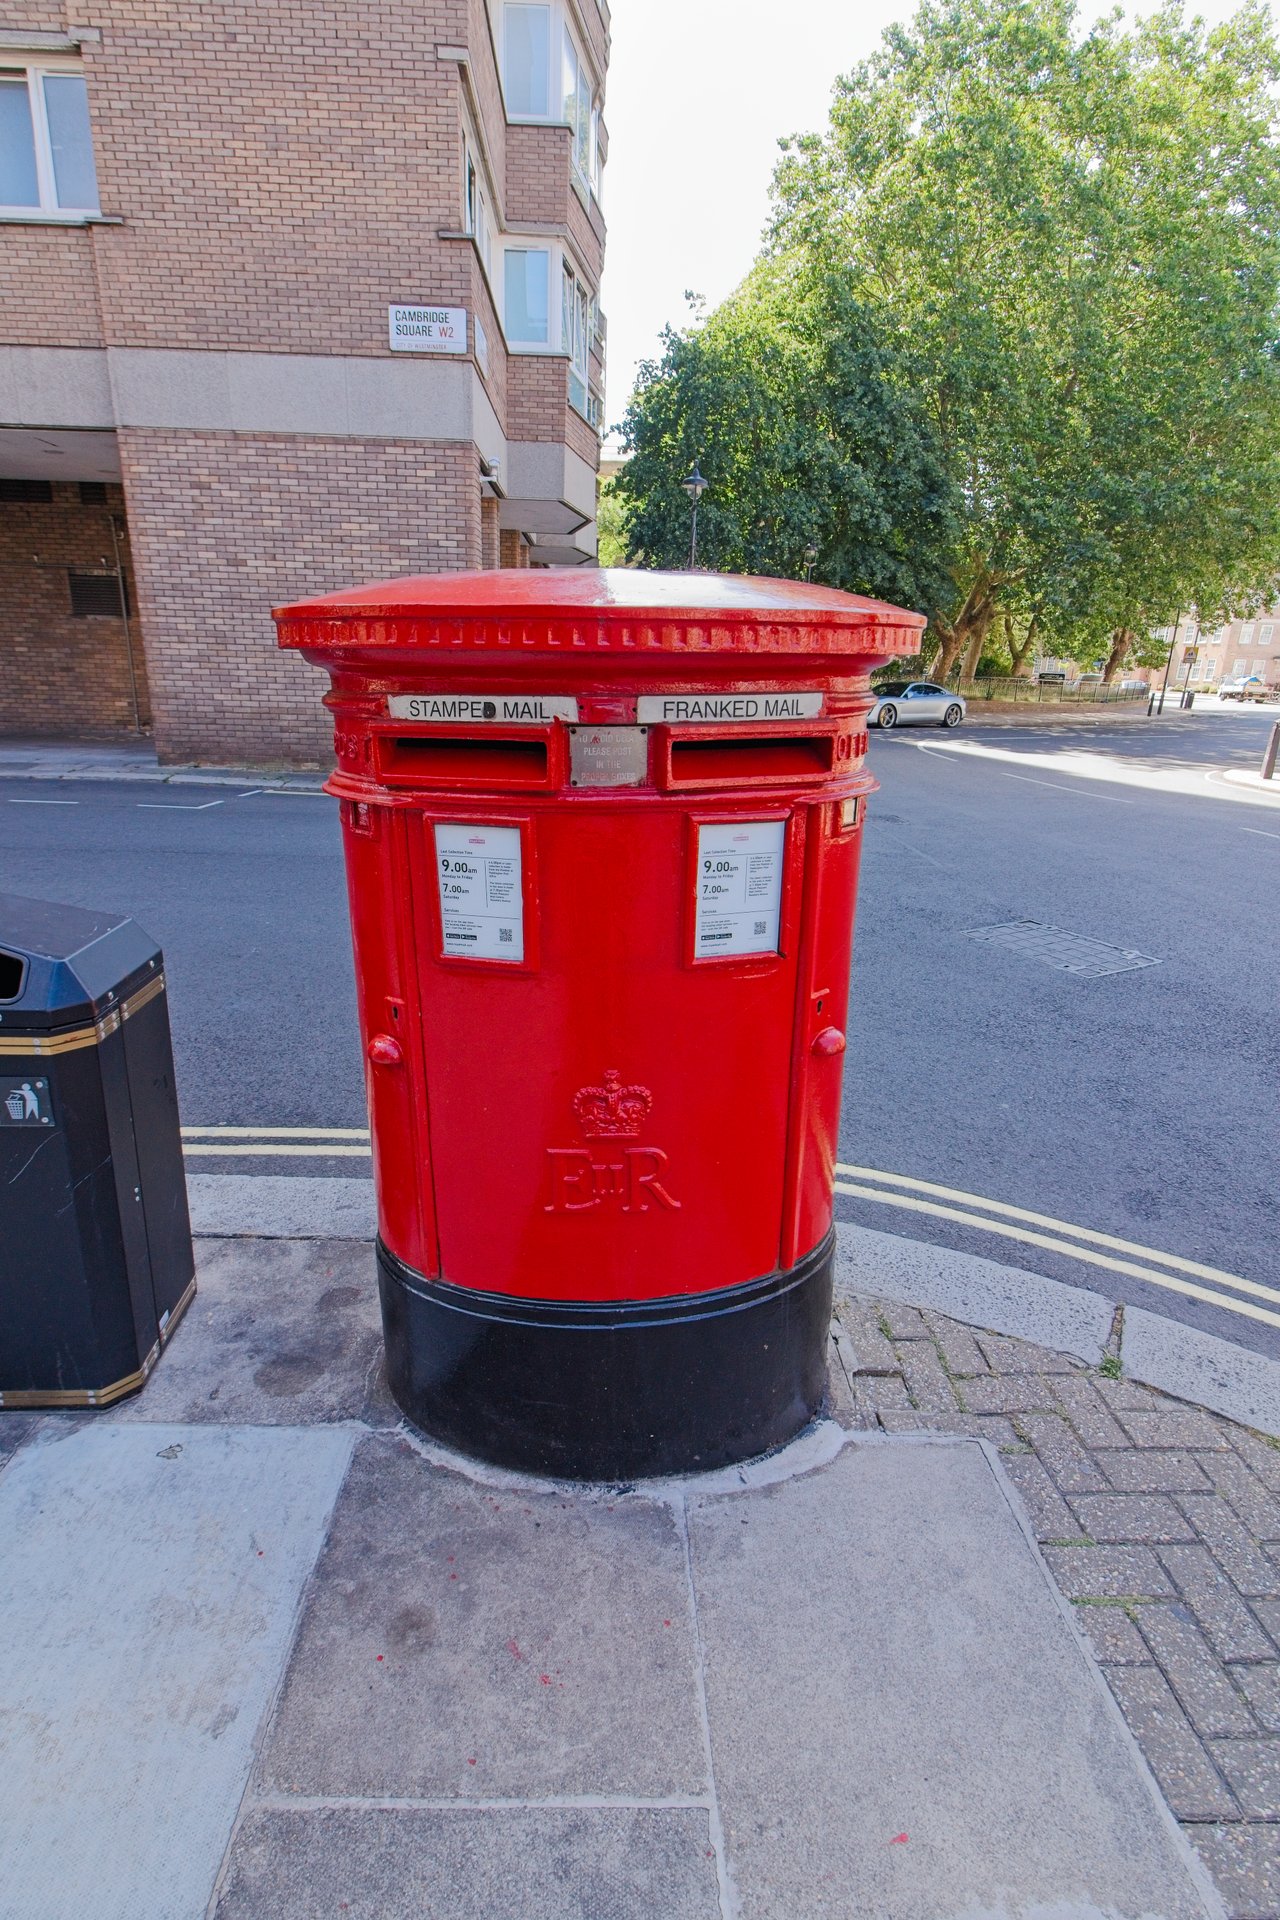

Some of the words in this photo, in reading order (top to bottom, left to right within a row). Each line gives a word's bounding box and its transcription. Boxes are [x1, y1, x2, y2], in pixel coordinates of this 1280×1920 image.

[395, 310, 450, 324] CAMBRIDGE
[395, 324, 433, 337] SQUARE
[438, 326, 454, 338] W2
[409, 700, 496, 719] STAMPED
[503, 701, 551, 719] MAIL
[663, 700, 758, 719] FRANKED
[764, 699, 804, 717] MAIL
[583, 747, 612, 756] PLEASE
[596, 760, 604, 769] IN
